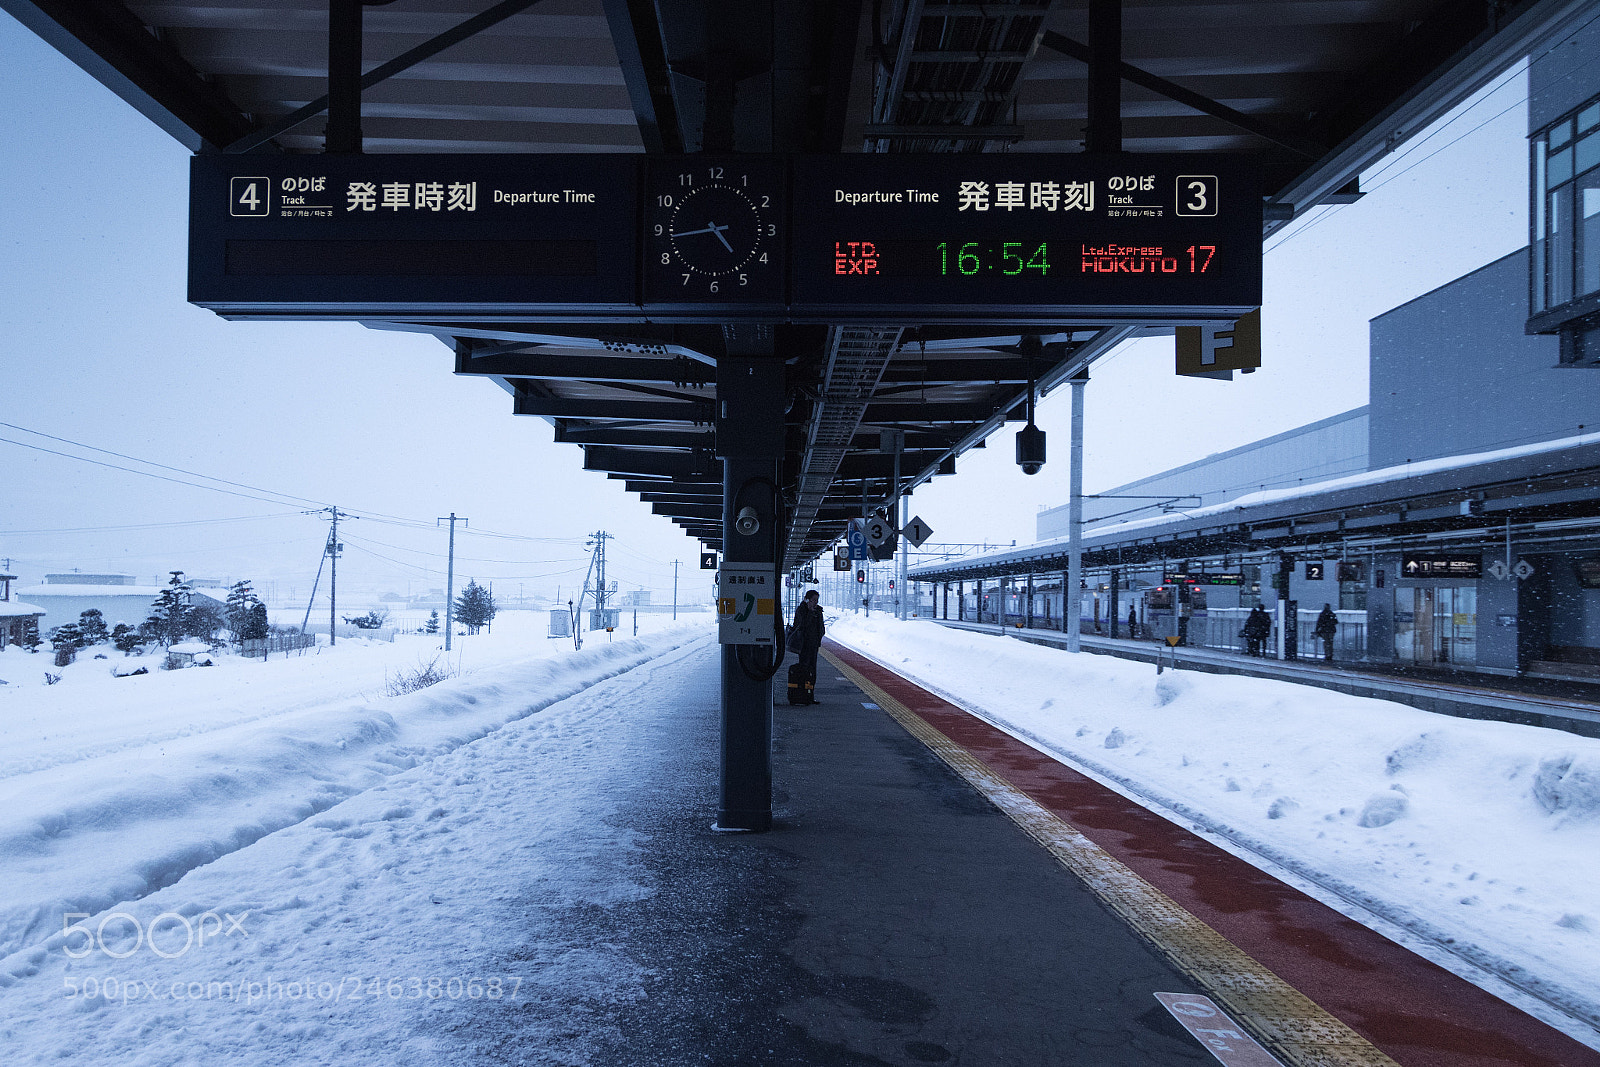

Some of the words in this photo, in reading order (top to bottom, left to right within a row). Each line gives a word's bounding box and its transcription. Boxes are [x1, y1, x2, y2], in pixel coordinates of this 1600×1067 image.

[678, 173, 692, 186] 11
[708, 167, 724, 179] 12
[281, 176, 327, 192] のりば
[741, 174, 747, 186] 1
[1108, 175, 1156, 191] のりば
[239, 182, 261, 211] 4
[281, 195, 306, 205] Track
[346, 181, 477, 212] 発車時刻
[493, 189, 560, 206] Departure
[563, 189, 596, 203] Time
[656, 194, 673, 207] 10
[761, 195, 770, 208] 2
[835, 189, 903, 206] Departure
[906, 189, 940, 203] Time
[958, 180, 1095, 212] 発車時刻
[1108, 194, 1134, 204] Track
[1187, 181, 1207, 211] 3
[654, 224, 663, 237] 9
[767, 224, 777, 237] 3
[835, 241, 881, 258] LTD.
[660, 252, 670, 265] 8
[759, 252, 769, 265] 4
[936, 242, 1051, 276] 16:54
[1081, 257, 1177, 273] HOKUTO
[1186, 245, 1216, 273] 17
[835, 258, 881, 275] EXP.
[681, 273, 691, 286] 7
[739, 273, 748, 286] 5
[710, 281, 719, 293] 6
[1201, 326, 1235, 365] F
[871, 524, 883, 540] 3
[913, 524, 920, 541] 1
[853, 547, 862, 559] E
[705, 557, 713, 567] 4
[840, 559, 848, 568] D
[1422, 562, 1429, 571] 1
[1311, 567, 1320, 578] 2
[1497, 565, 1503, 576] 1
[1519, 565, 1527, 575] 3
